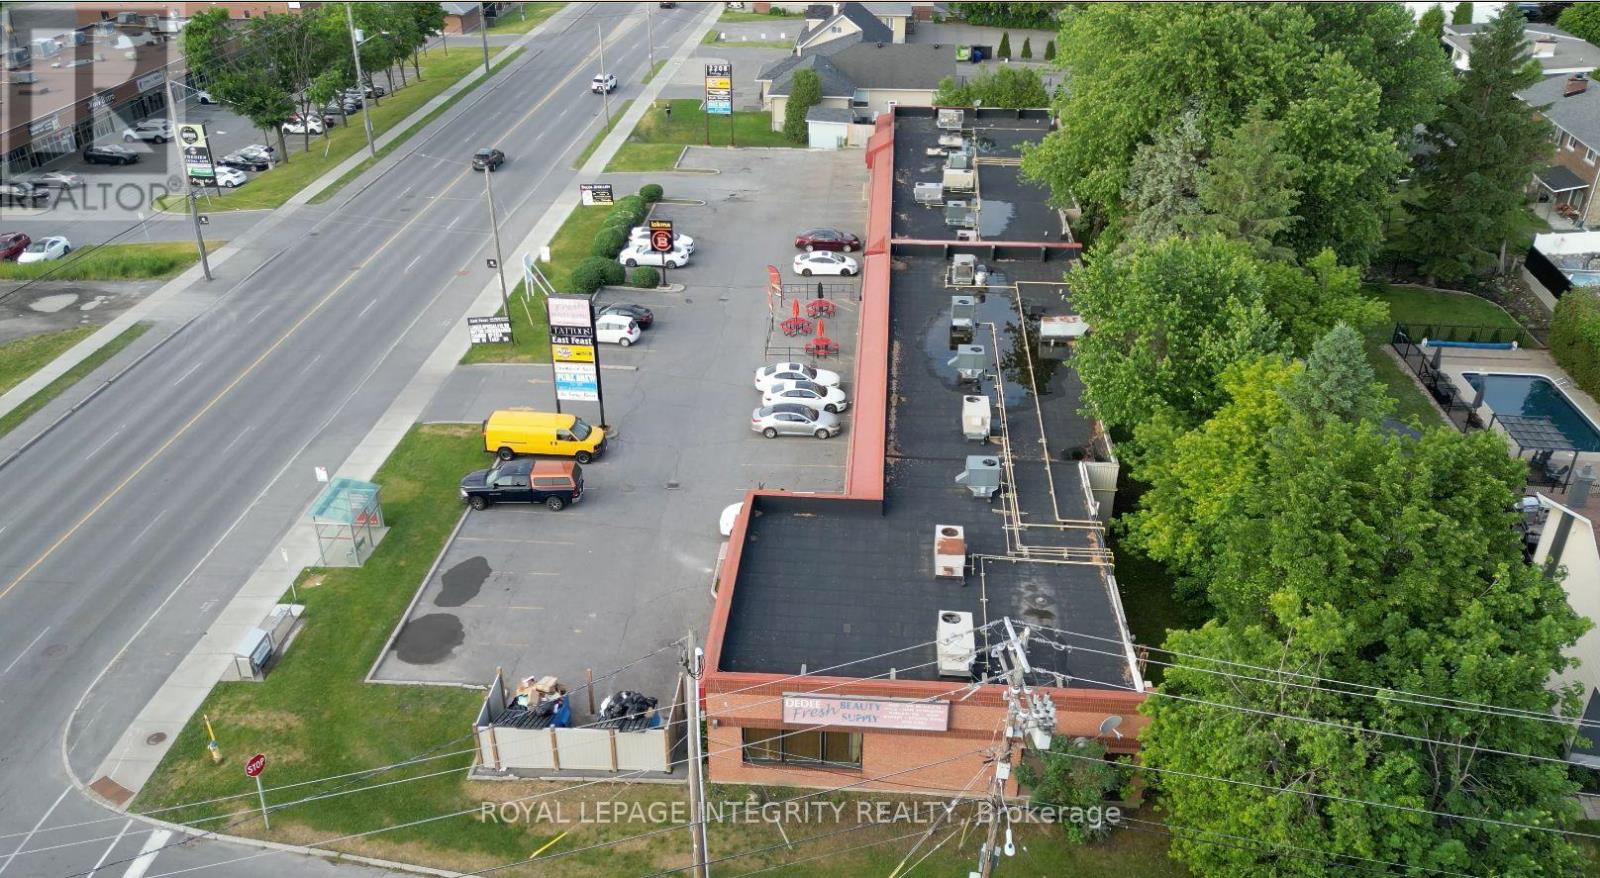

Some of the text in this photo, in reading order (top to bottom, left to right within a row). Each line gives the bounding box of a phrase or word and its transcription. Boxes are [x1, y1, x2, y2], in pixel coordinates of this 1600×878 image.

[552, 335, 593, 345] East Feast
[840, 701, 881, 711] BEAUTY
[793, 703, 837, 721] Fresh
[841, 713, 878, 723] SUPPLY
[247, 757, 265, 774] STOP
